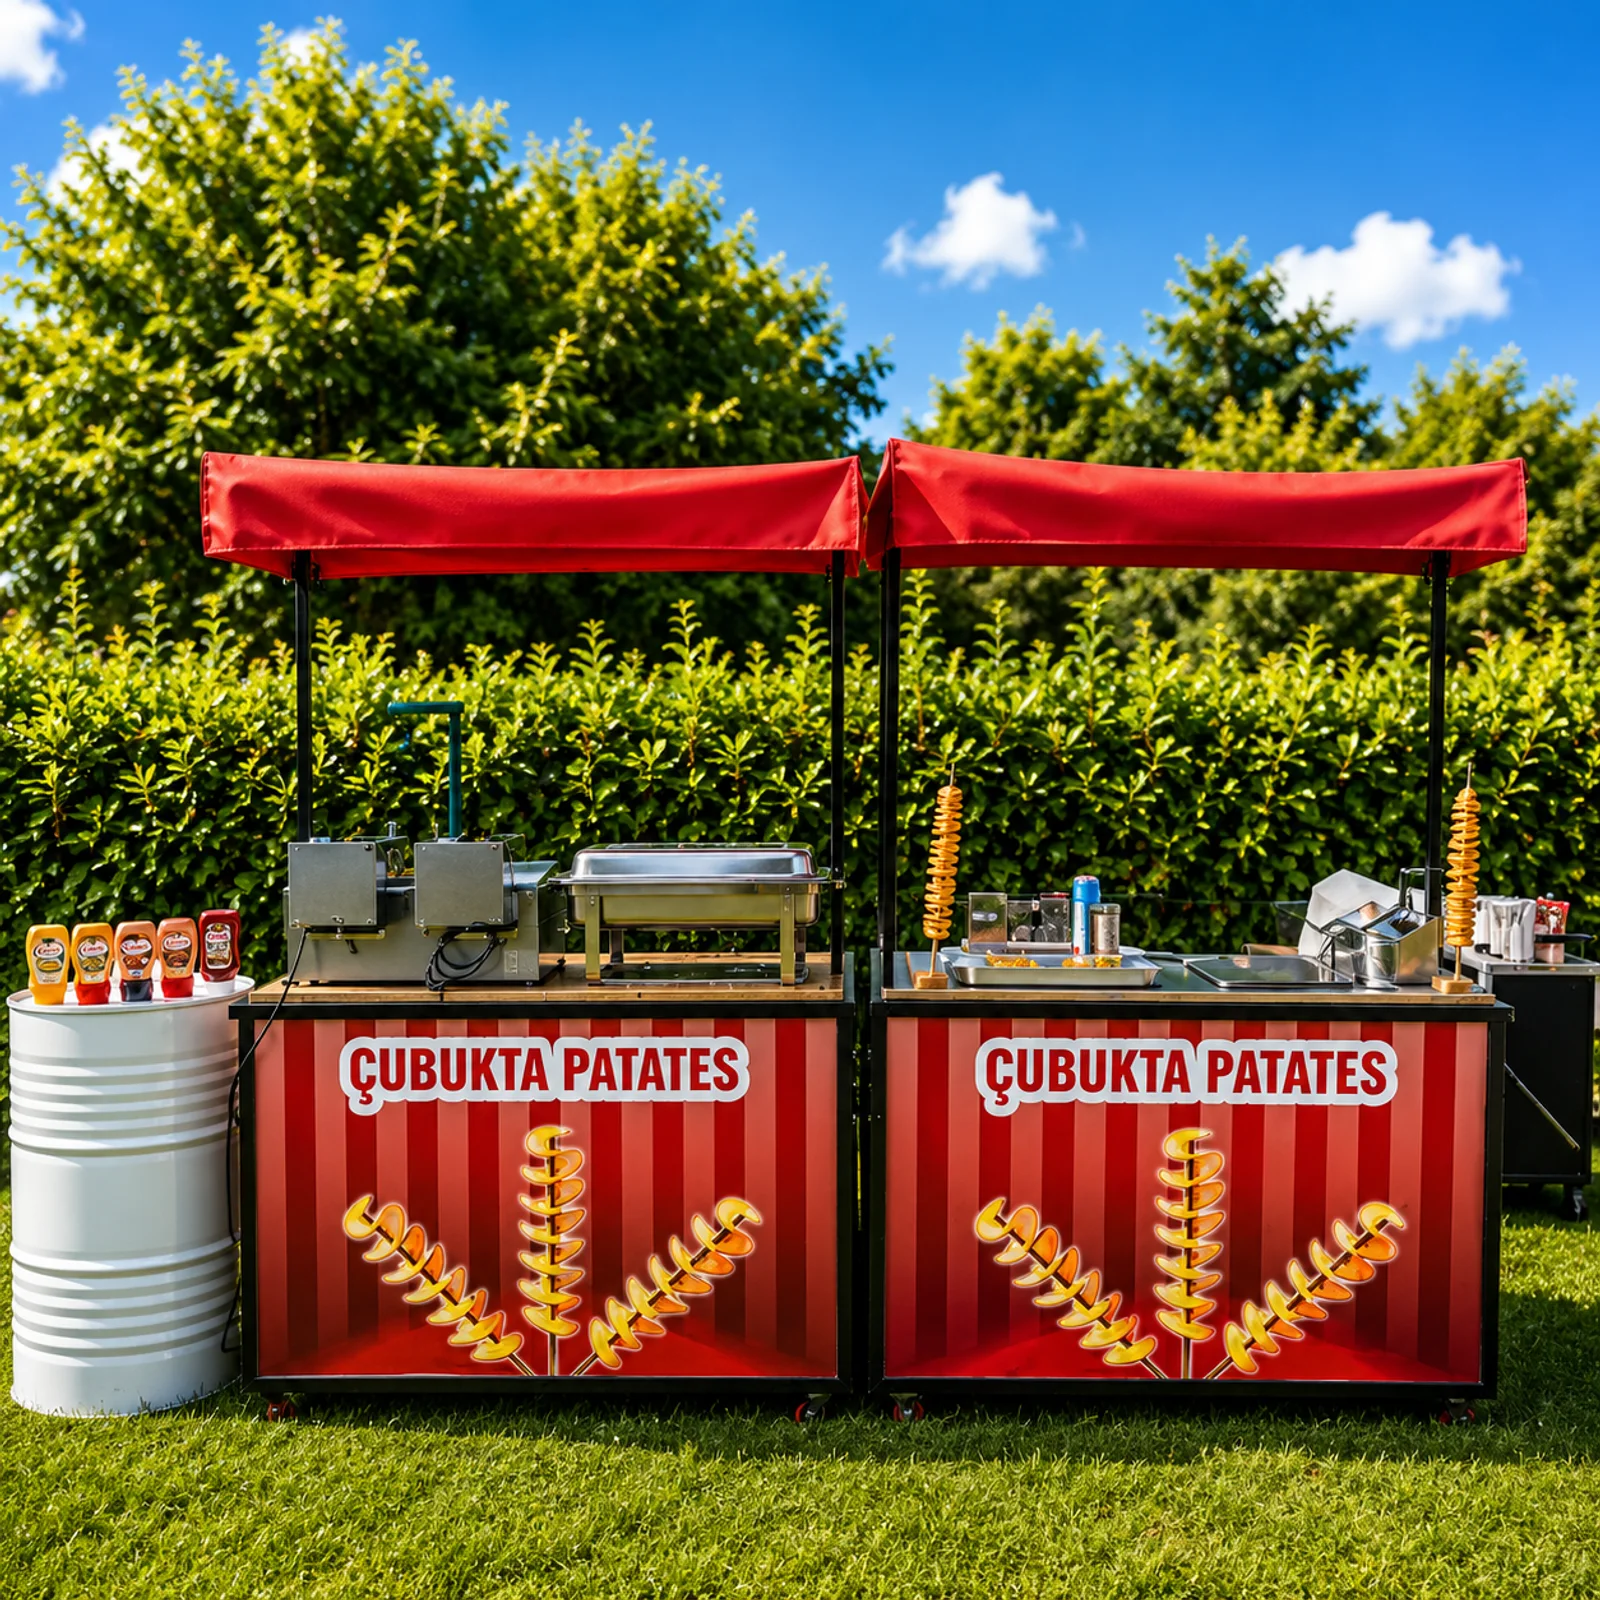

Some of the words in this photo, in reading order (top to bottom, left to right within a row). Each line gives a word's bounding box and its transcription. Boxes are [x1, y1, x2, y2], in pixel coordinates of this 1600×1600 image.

[350, 1047, 548, 1105] ÇUBUKTA
[564, 1047, 738, 1091] PATATES
[986, 1048, 1190, 1106] ÇUBUKTA
[1208, 1050, 1387, 1095] PATATES
